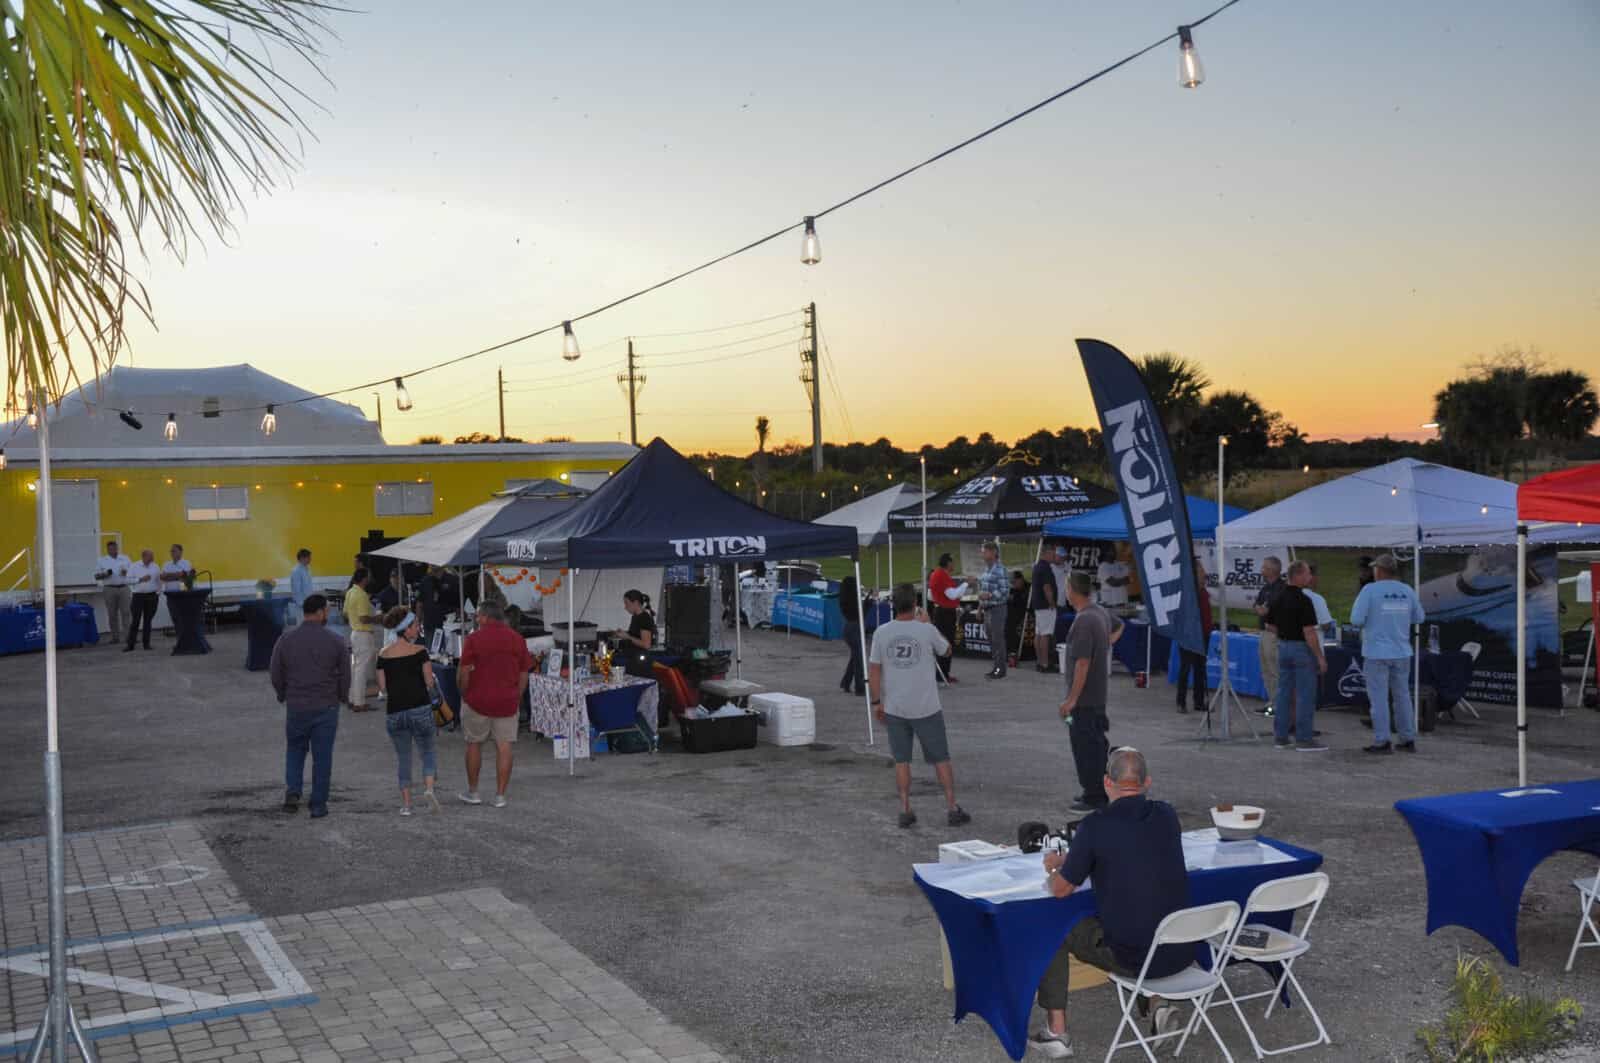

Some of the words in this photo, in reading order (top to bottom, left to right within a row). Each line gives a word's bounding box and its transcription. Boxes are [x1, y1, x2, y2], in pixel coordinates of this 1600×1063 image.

[1021, 475, 1080, 493] SFR
[1104, 400, 1182, 627] TRITON
[668, 536, 766, 557] TRITON
[1070, 546, 1101, 568] SFR
[964, 623, 988, 640] SFR
